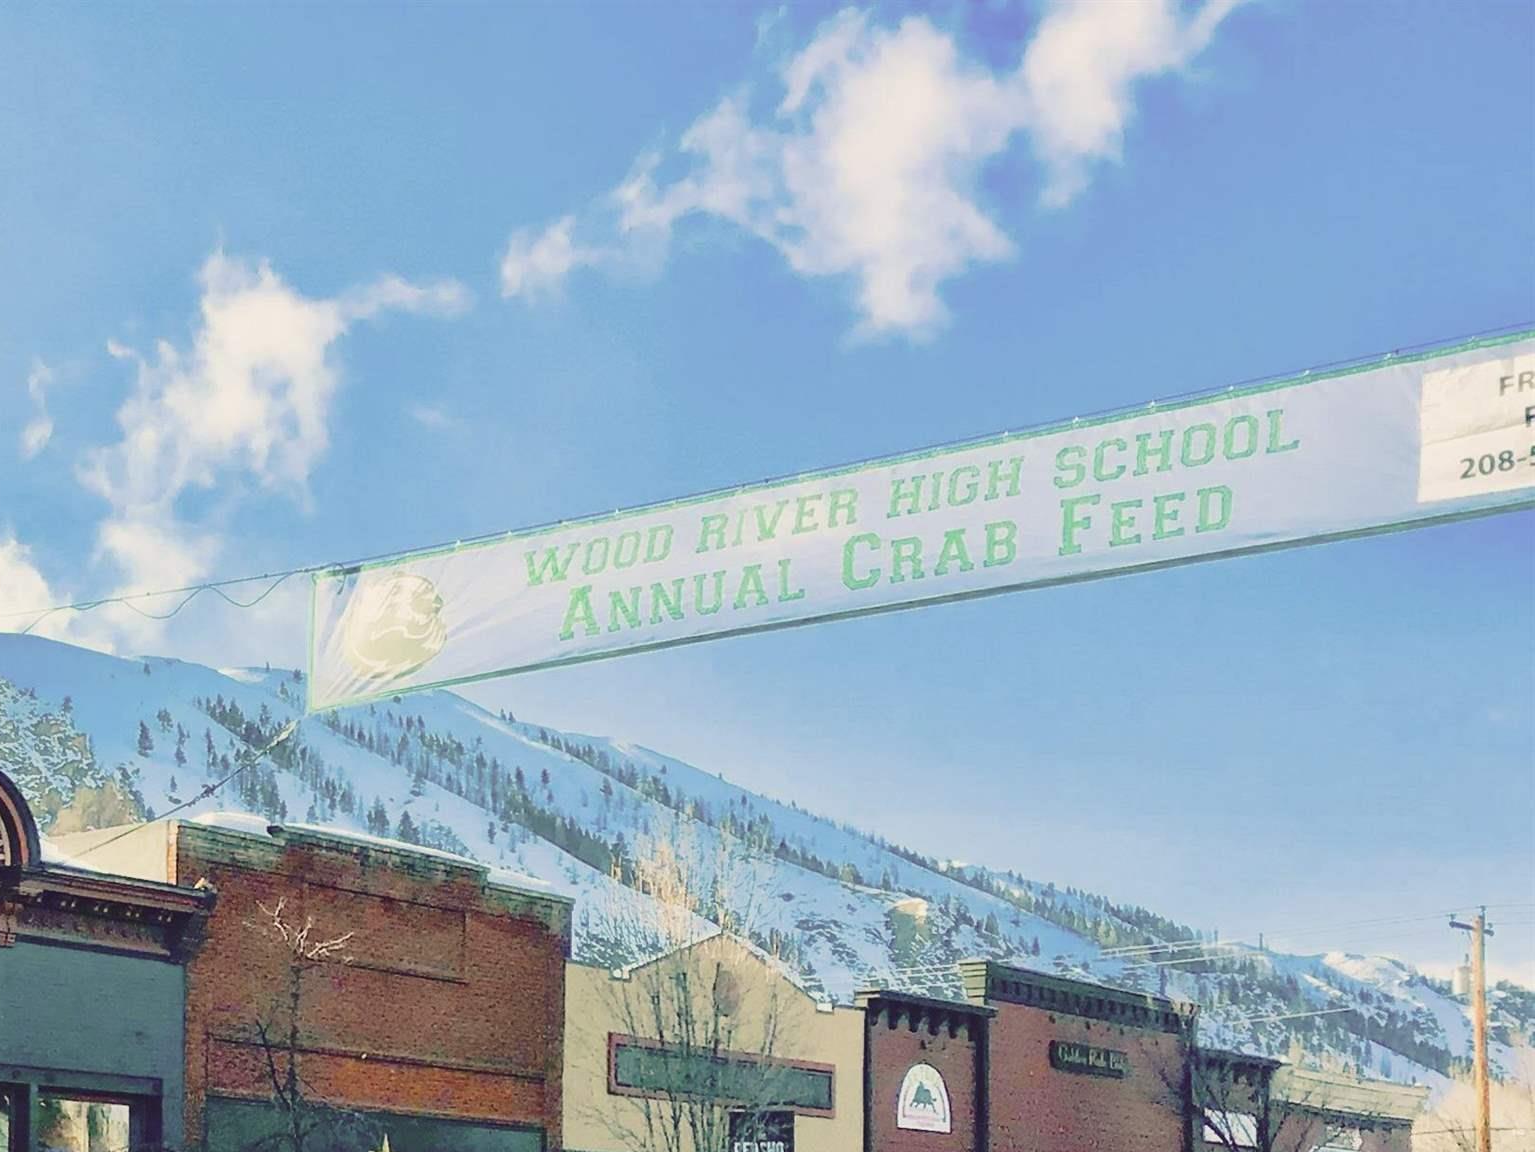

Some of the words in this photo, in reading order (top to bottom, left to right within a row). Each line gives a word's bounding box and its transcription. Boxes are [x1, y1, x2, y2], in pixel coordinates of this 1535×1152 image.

[522, 524, 675, 587] WOOD
[696, 487, 860, 554] RIVER
[886, 455, 1025, 520] HIGH
[1052, 408, 1301, 489] SCHOOL
[559, 558, 806, 642] ANNUAL
[841, 519, 1018, 591] CRAB
[1058, 483, 1234, 557] FEED
